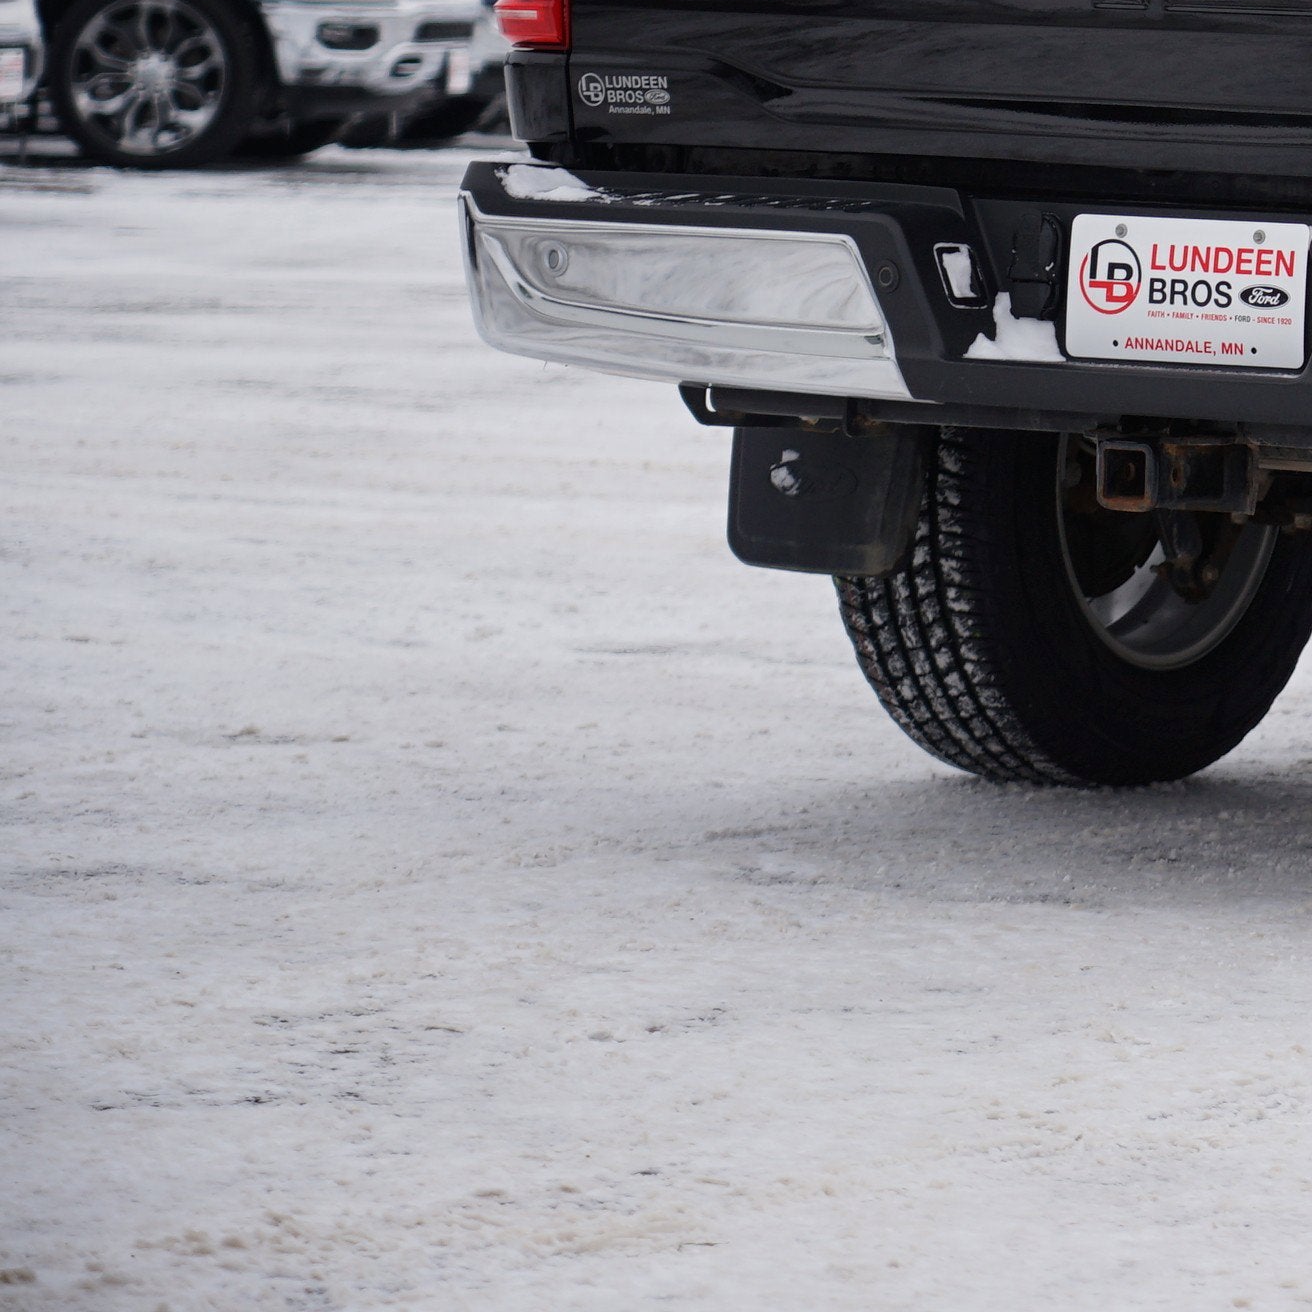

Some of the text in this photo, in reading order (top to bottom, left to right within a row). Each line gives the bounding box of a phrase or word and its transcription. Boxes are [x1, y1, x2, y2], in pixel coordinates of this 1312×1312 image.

[604, 75, 668, 89] LUNDEEN
[606, 90, 645, 104] BROS
[655, 105, 671, 115] MN
[1149, 243, 1296, 278] LUNDEEN
[1147, 277, 1233, 309] BROS
[1247, 286, 1282, 307] Ford
[1147, 310, 1293, 326] FAITH FAMILY FRIENDS FORD SINCE 1920
[1124, 336, 1244, 357] ANNANDALE, MN
